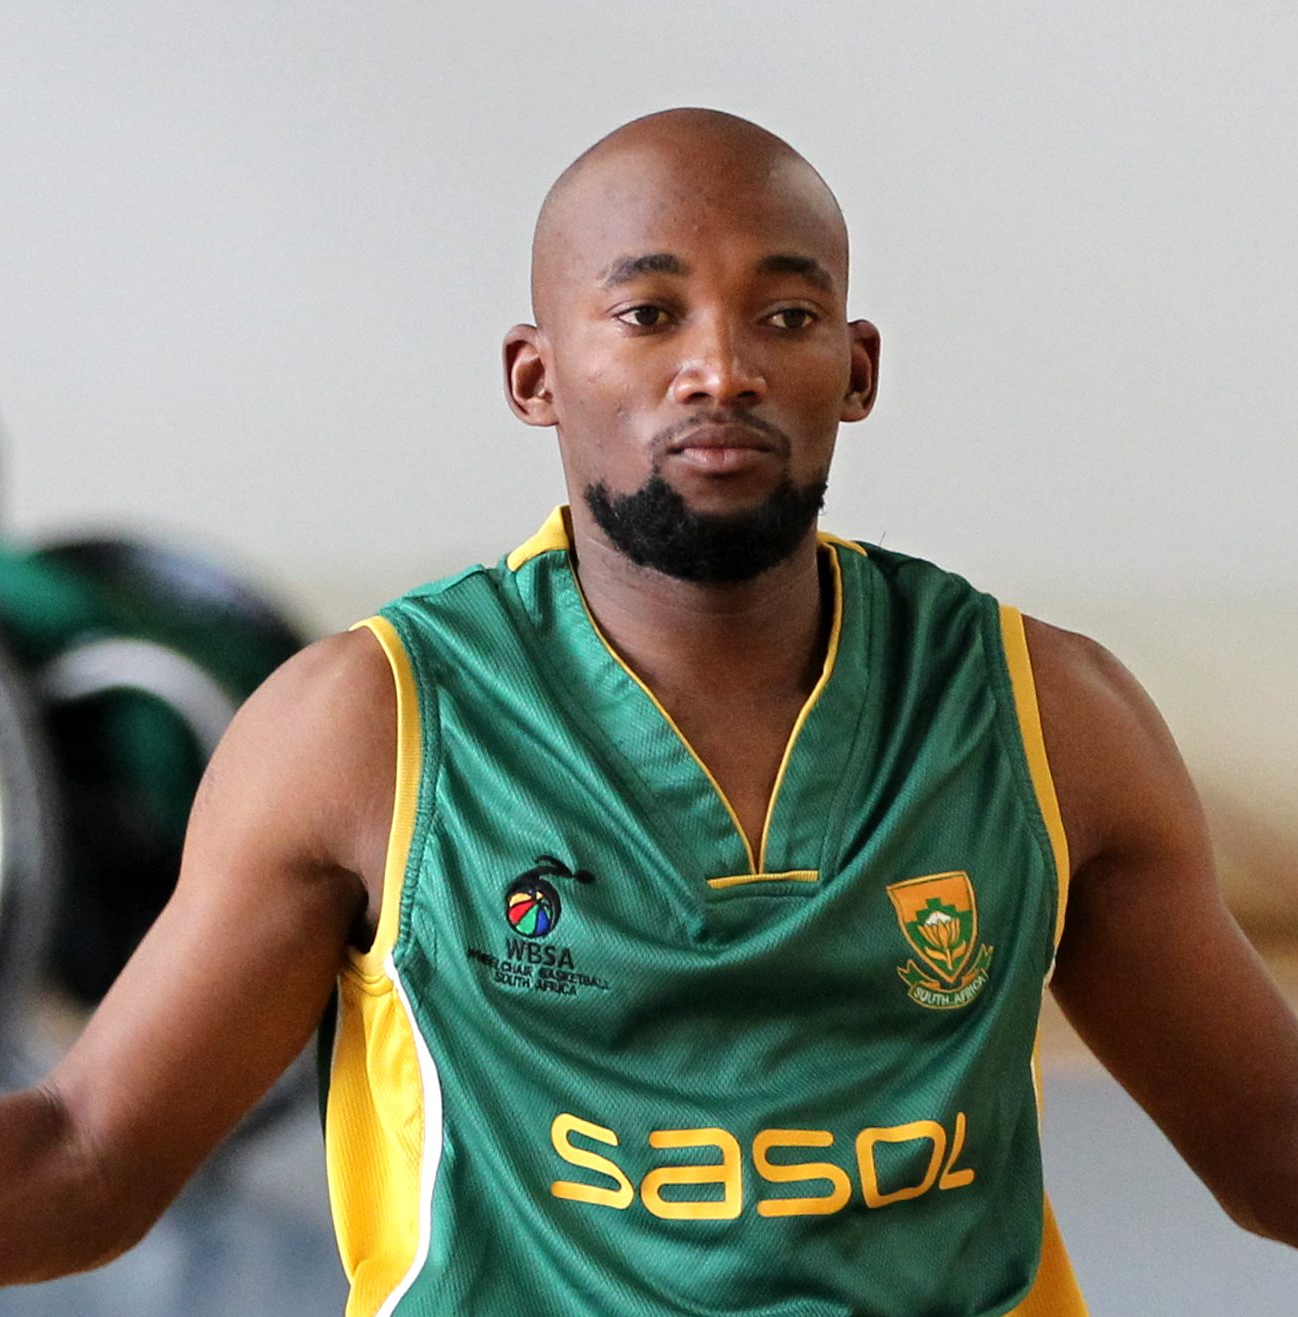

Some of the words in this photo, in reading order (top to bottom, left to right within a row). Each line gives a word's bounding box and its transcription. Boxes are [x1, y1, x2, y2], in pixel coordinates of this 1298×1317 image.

[506, 937, 575, 970] WBSA
[494, 971, 531, 988] SOUTH
[535, 979, 577, 996] AFRICA
[913, 986, 950, 1006] SOUTH
[954, 975, 987, 1005] AFRICA
